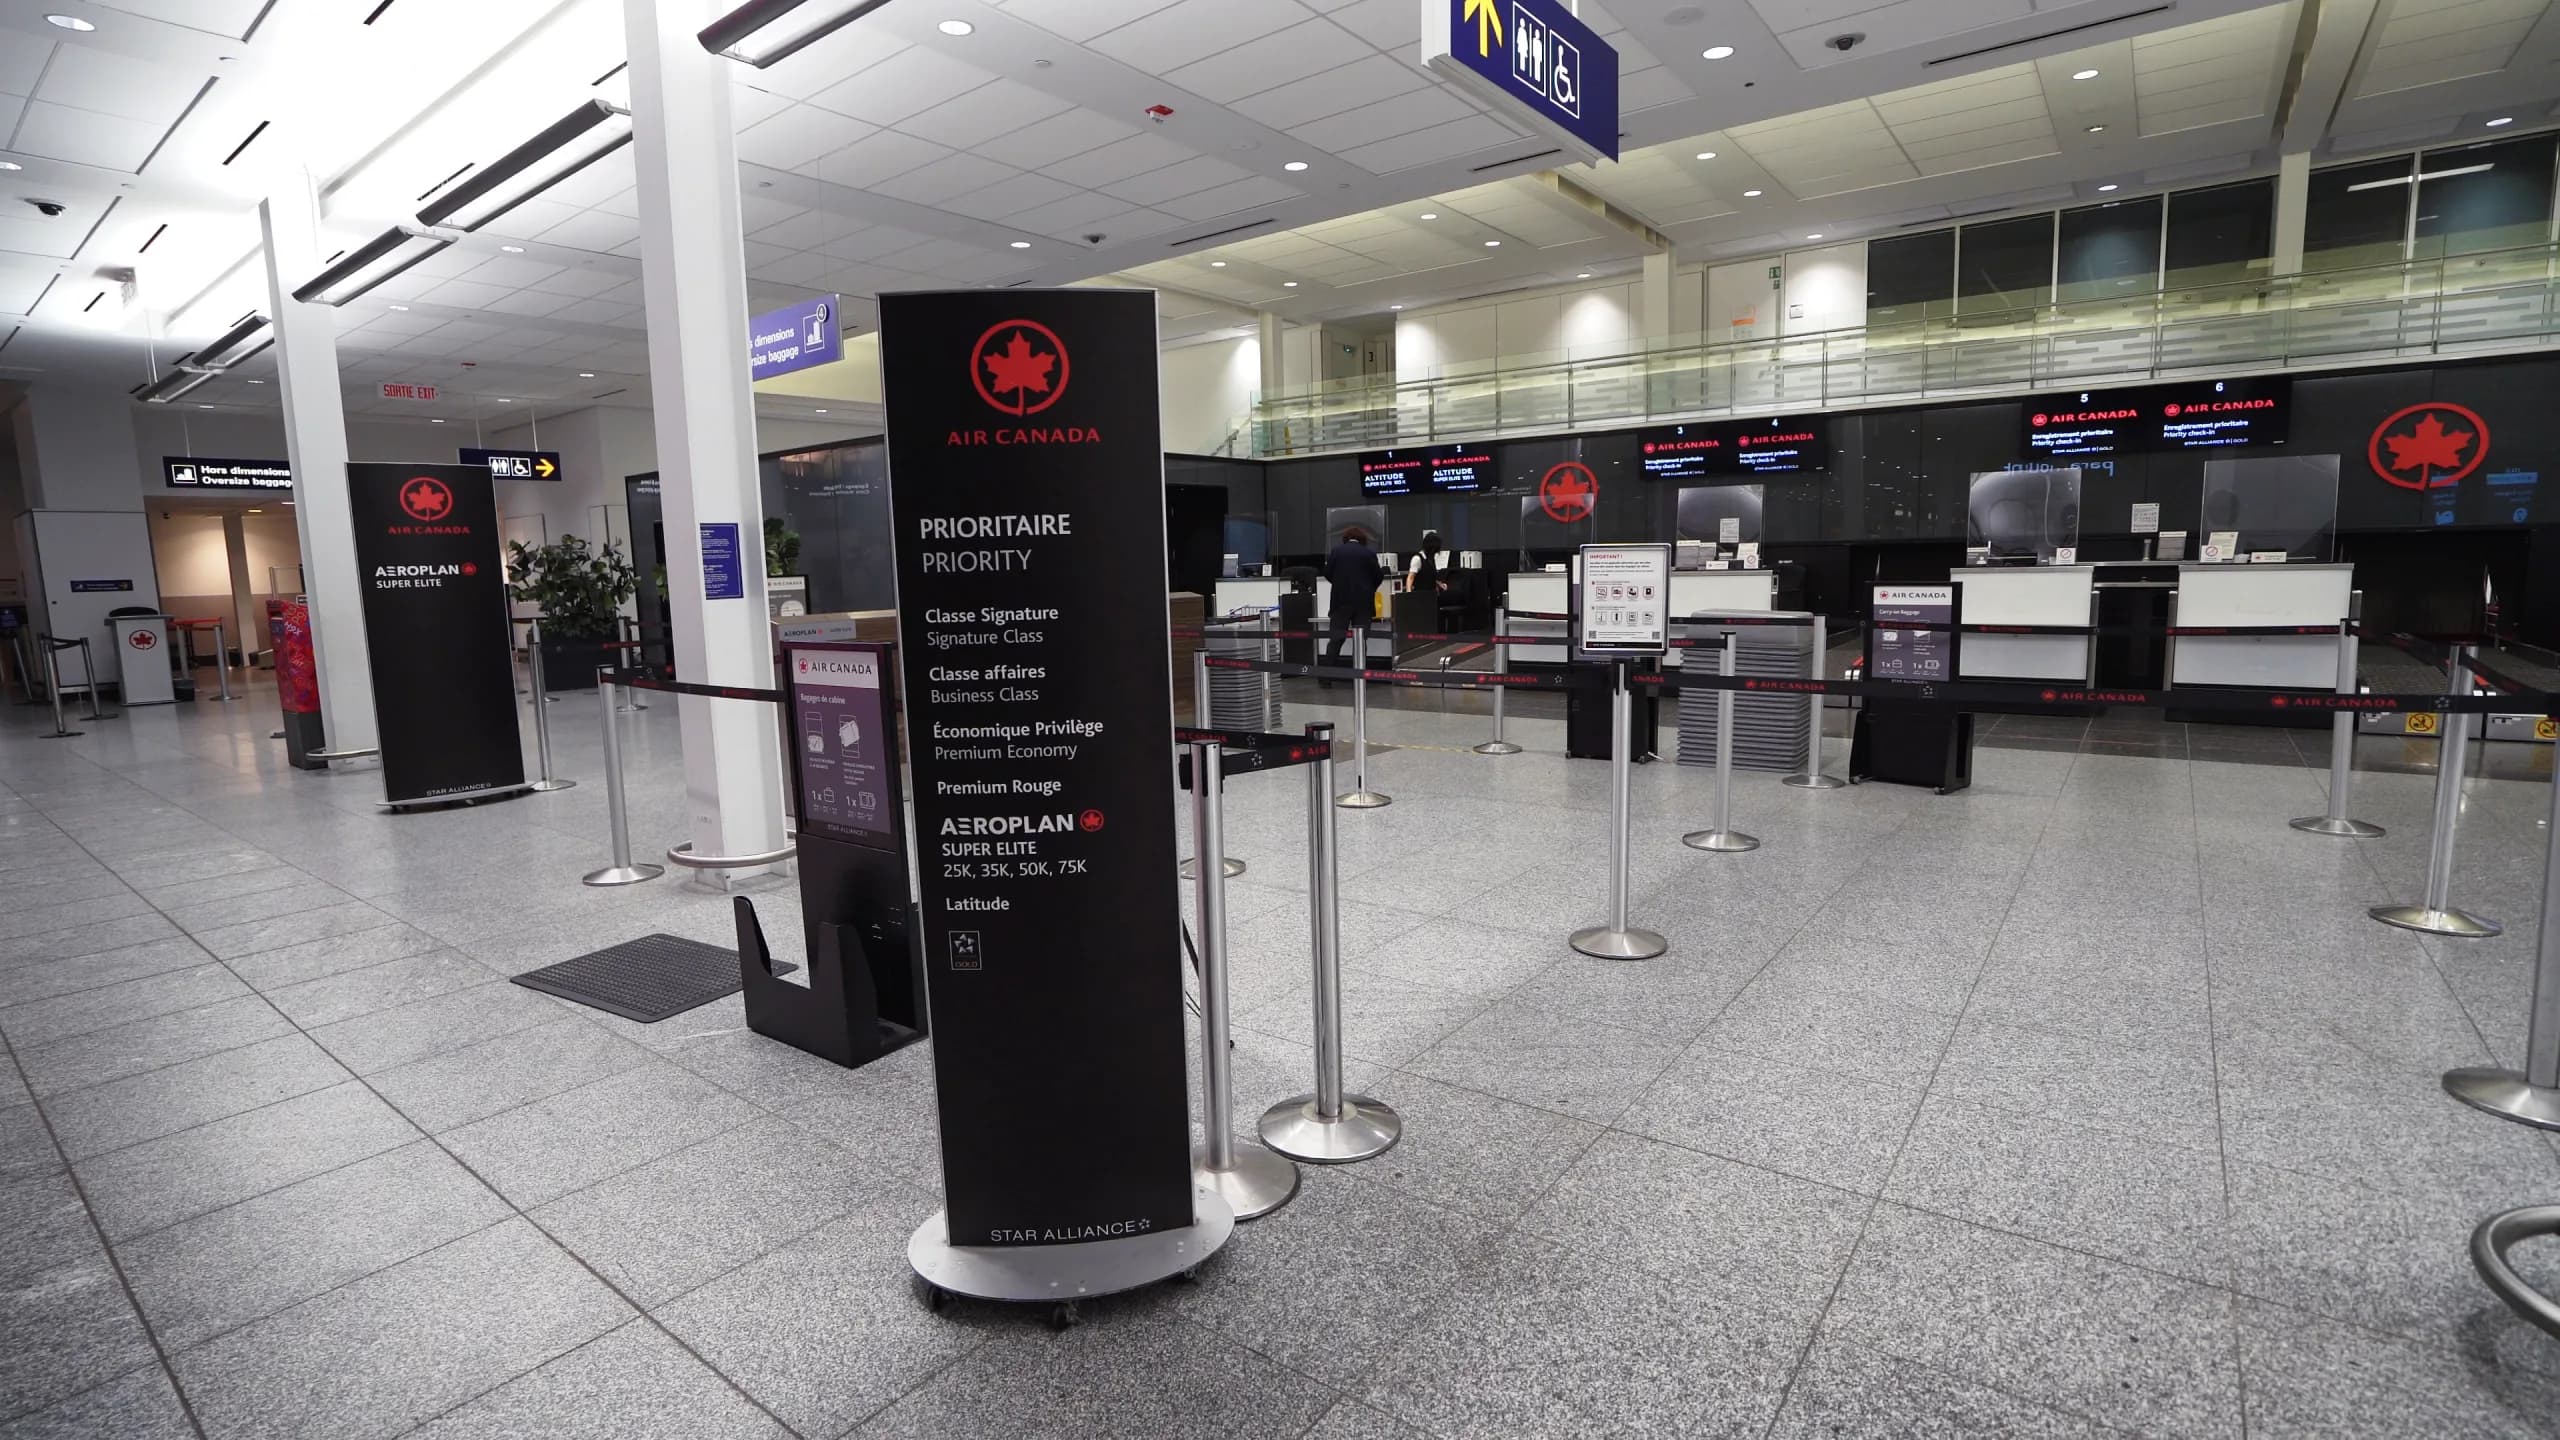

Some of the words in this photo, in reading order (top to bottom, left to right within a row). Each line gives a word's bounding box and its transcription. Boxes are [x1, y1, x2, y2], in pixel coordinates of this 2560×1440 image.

[755, 328, 795, 347] dimensions
[768, 346, 799, 363] baggage
[383, 384, 414, 398] SORTIE
[416, 386, 435, 400] EXIT
[2215, 382, 2224, 392] 6
[2080, 394, 2089, 403] 5
[2184, 404, 2209, 413] AIR
[2212, 399, 2275, 411] CANADA
[1771, 418, 1779, 427] 4
[2051, 414, 2075, 423] AIR
[2078, 409, 2138, 421] CANADA
[1677, 426, 1684, 434] 3
[2214, 420, 2249, 429] prioritaire
[947, 429, 988, 446] AIR
[995, 427, 1101, 445] CANADA
[1752, 436, 1769, 444] AIR
[1771, 433, 1814, 442] CANADA
[2187, 429, 2216, 437] check-in
[1676, 440, 1719, 449] CANADA
[1387, 461, 1421, 469] CANADA
[1456, 455, 1491, 464] CANADA
[200, 465, 227, 475] Hors
[230, 466, 290, 477] dimensions
[1364, 472, 1404, 482] ALTITUDE
[1433, 467, 1473, 477] ALTITUDE
[202, 476, 250, 486] Oversize
[388, 525, 412, 535] AIR
[415, 525, 471, 535] CANADA
[919, 513, 1072, 540] PRIORITAIRE
[922, 549, 1033, 574] PRIORITY
[375, 564, 460, 578] AEROPLAN
[376, 578, 412, 589] SUPER
[414, 578, 442, 589] ELITE
[925, 607, 976, 624] Classe
[981, 606, 1059, 626] Signature
[927, 630, 998, 650] Signature
[1003, 628, 1044, 644] Class
[811, 661, 828, 673] AIR
[829, 662, 872, 675] CANADA
[929, 665, 980, 682] Classe
[984, 664, 1046, 681] affaires
[1779, 683, 1825, 691] CANADA
[931, 688, 995, 703] Business
[999, 686, 1039, 702] Class
[2061, 692, 2083, 701] AIR
[2086, 693, 2146, 703] CANADA
[2293, 698, 2321, 707] AIR
[2324, 697, 2397, 708] CANADA
[933, 721, 1031, 741] Économique
[1035, 719, 1104, 737] Privilège
[935, 745, 1002, 760] Premium
[1007, 744, 1078, 760] Economy
[426, 787, 447, 797] STAR
[448, 783, 486, 793] ALLIANCE
[937, 780, 1007, 795] Premium
[1012, 779, 1062, 796] Rouge
[940, 813, 1075, 836] AEROPLAN
[941, 842, 991, 857] SUPER
[996, 841, 1037, 856] ELITE
[944, 863, 976, 879] 25K,
[980, 862, 1014, 878] 35K,
[1019, 861, 1053, 877] 50K,
[1058, 859, 1088, 875] 75K
[946, 896, 1010, 911] Latitude
[990, 1229, 1037, 1242] STAR
[1043, 1220, 1137, 1241] ALLIANCE
